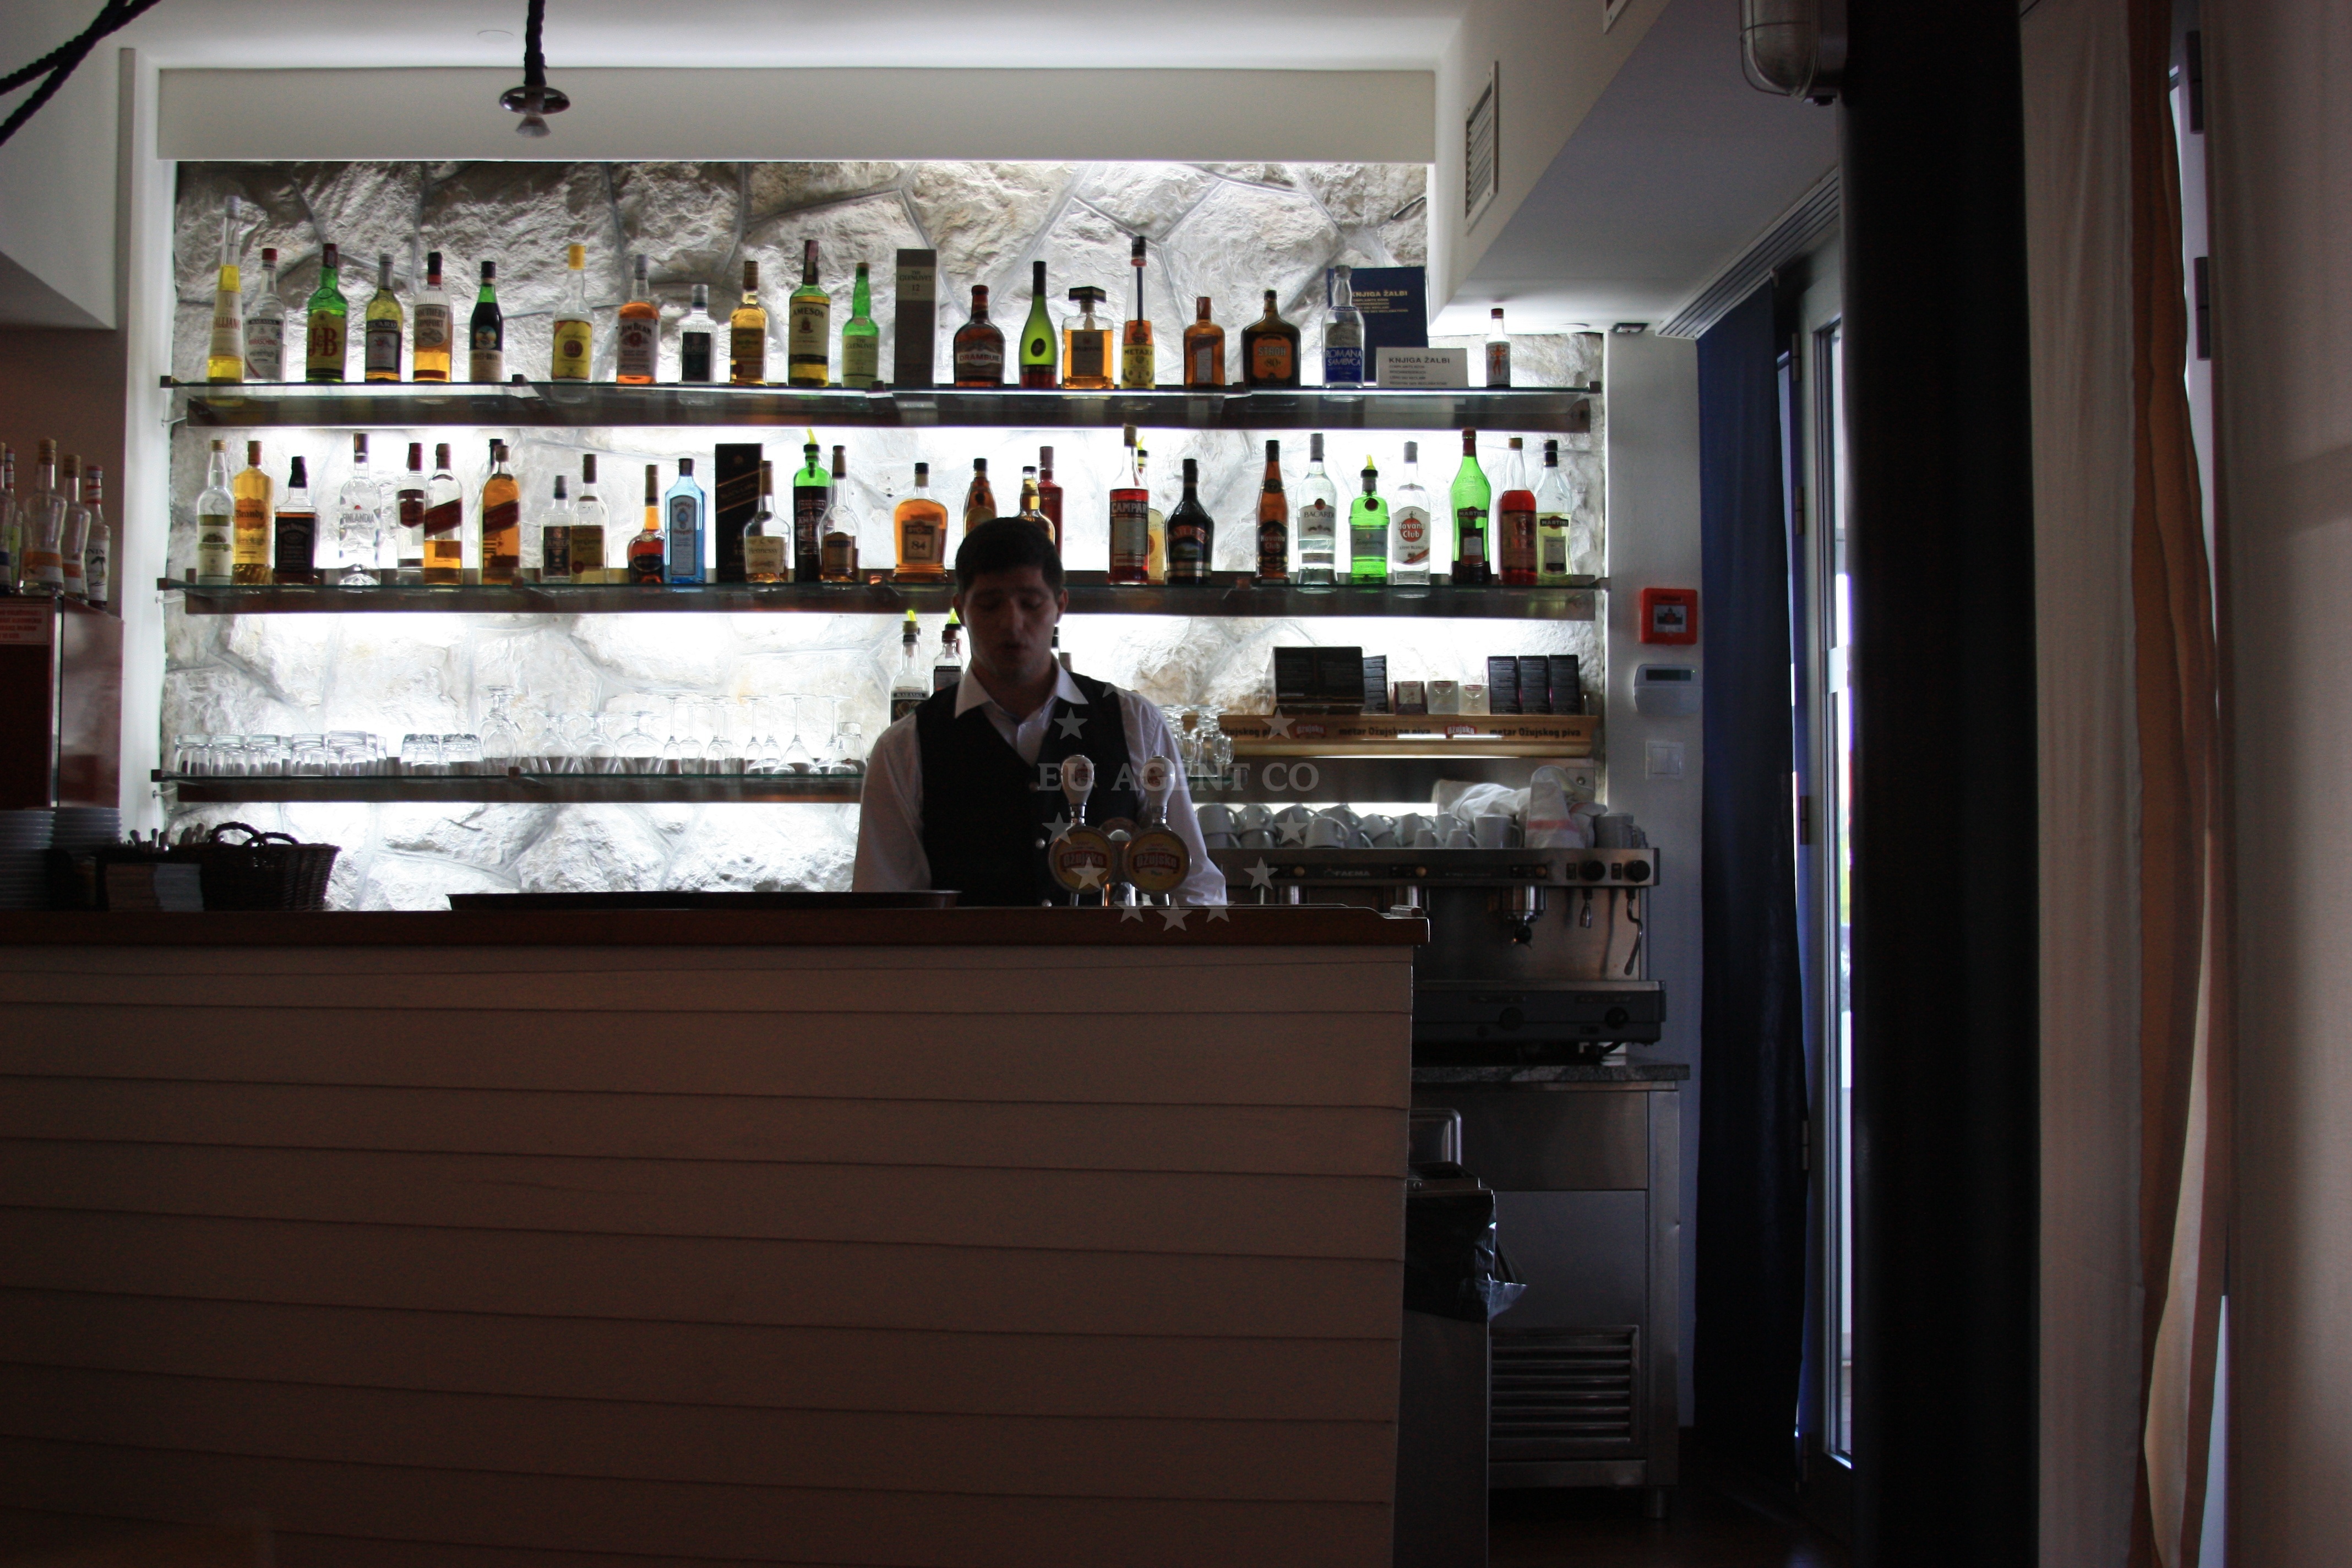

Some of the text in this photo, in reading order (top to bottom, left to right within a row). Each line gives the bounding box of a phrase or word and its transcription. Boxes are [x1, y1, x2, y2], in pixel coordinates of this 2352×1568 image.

[415, 308, 446, 317] SOUTHERN
[793, 307, 824, 318] AMESON
[620, 323, 652, 336] JIM BEAM
[308, 328, 337, 357] J&B
[1258, 347, 1286, 356] STROH
[1326, 350, 1362, 358] ROMANA
[1112, 502, 1147, 513] CAMPAR
[236, 510, 264, 519] Brandy
[343, 513, 375, 522] FINLANDIA
[797, 516, 821, 524] AMAR
[1169, 525, 1207, 541] BAILEYS
[911, 541, 926, 550] 84
[1295, 725, 1324, 734] Ožujsko
[1447, 726, 1475, 734] Ožujsko
[1490, 727, 1580, 738] metar Ožujskog piva
[1063, 853, 1104, 868] Ožujsko
[1136, 854, 1178, 868] Ožujsko
